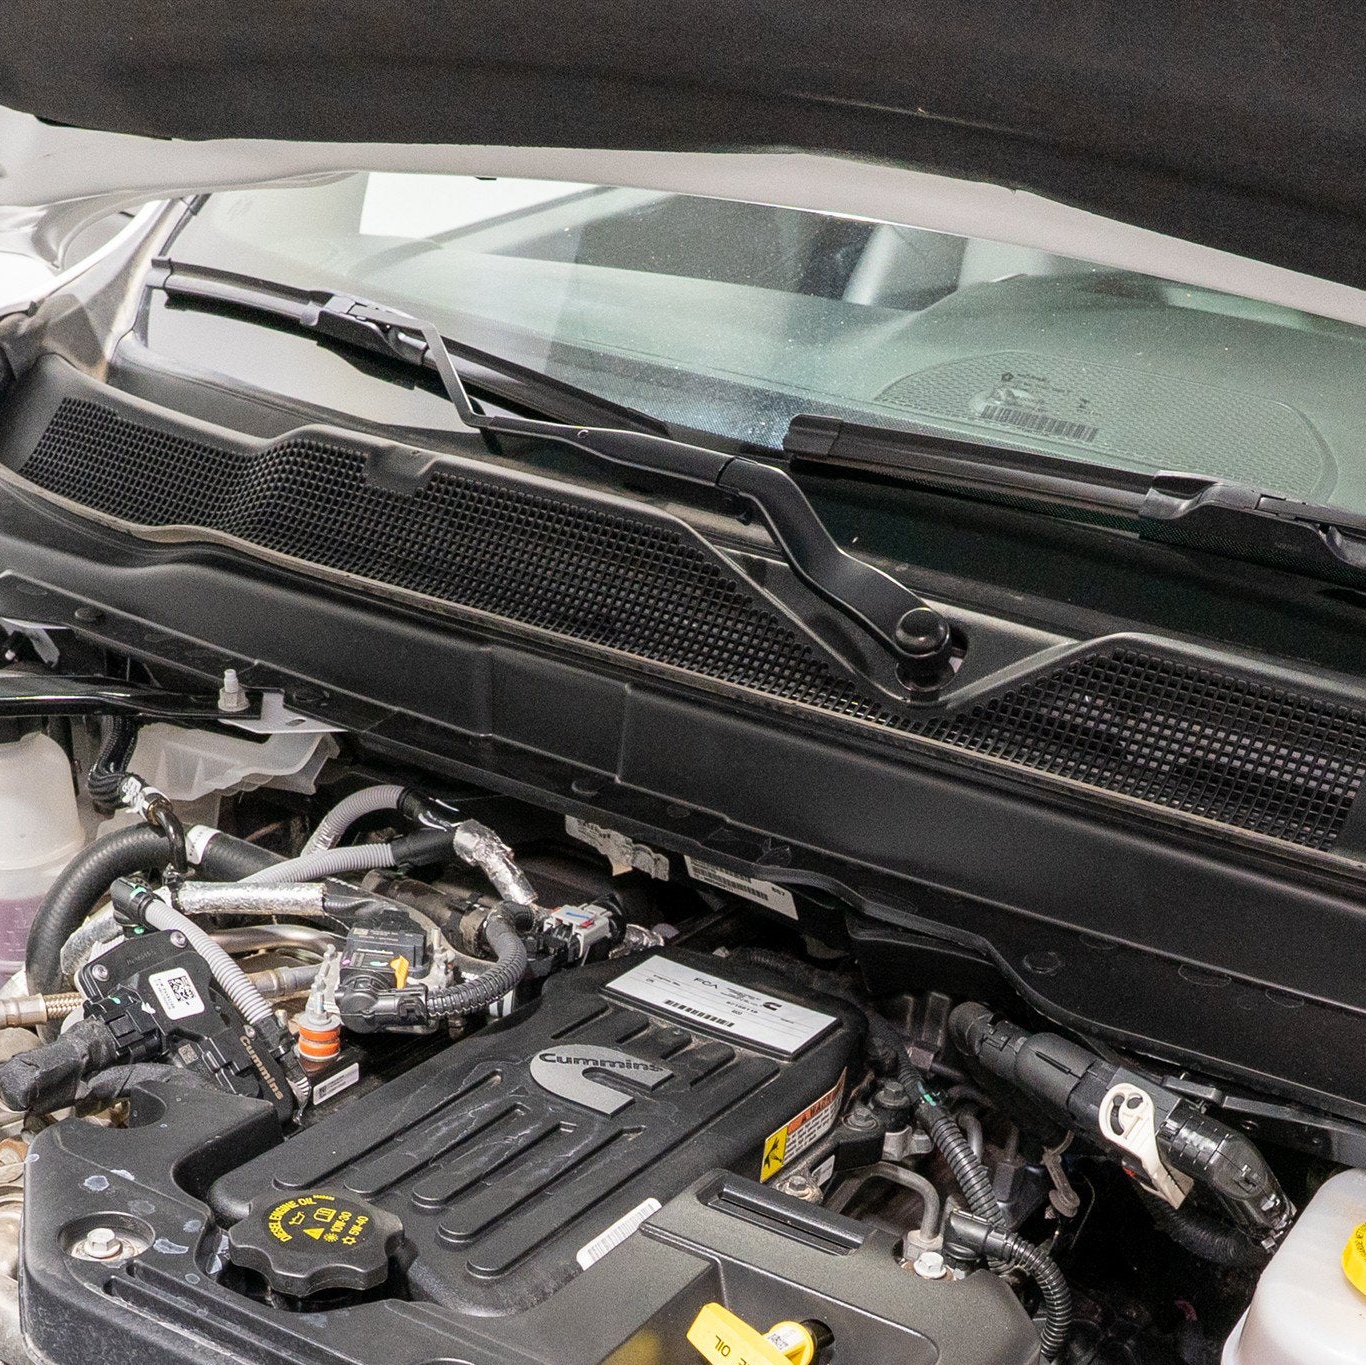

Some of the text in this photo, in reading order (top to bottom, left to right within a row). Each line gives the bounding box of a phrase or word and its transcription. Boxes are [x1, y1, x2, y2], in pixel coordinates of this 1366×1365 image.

[239, 1035, 284, 1100] Cummins
[539, 1053, 664, 1072] Cummins
[268, 1197, 317, 1243] DIESEL ENGINE OIL
[330, 1211, 353, 1233] 10W-30
[348, 1215, 369, 1236] 5W-40
[714, 1334, 732, 1358] OIL
